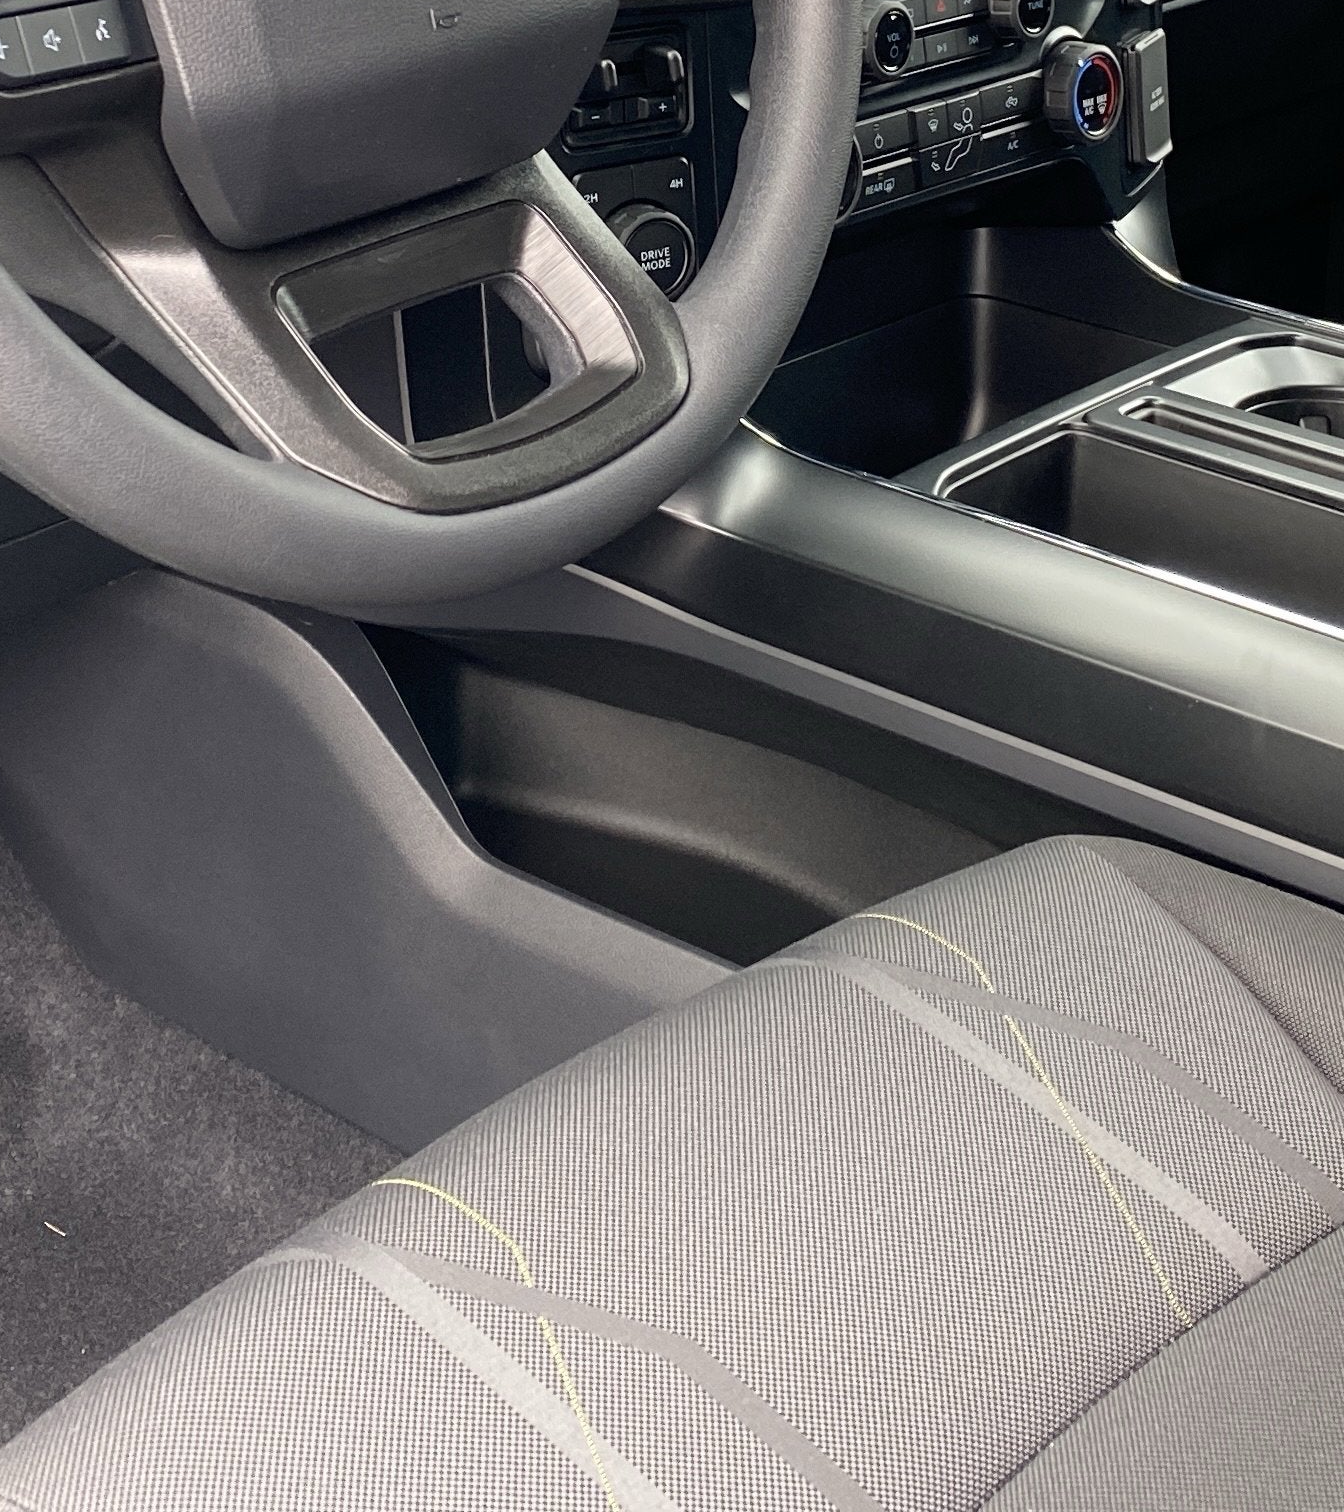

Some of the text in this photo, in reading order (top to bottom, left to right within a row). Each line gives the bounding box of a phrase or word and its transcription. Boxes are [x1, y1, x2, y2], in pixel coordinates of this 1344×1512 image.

[1027, 0, 1044, 10] TUNE
[887, 33, 901, 43] VOL
[1082, 97, 1094, 108] MAX
[669, 177, 684, 189] 4H
[865, 182, 884, 196] REAR
[583, 192, 599, 204] 2H
[640, 247, 671, 261] DRIVE
[641, 257, 672, 271] MODE
